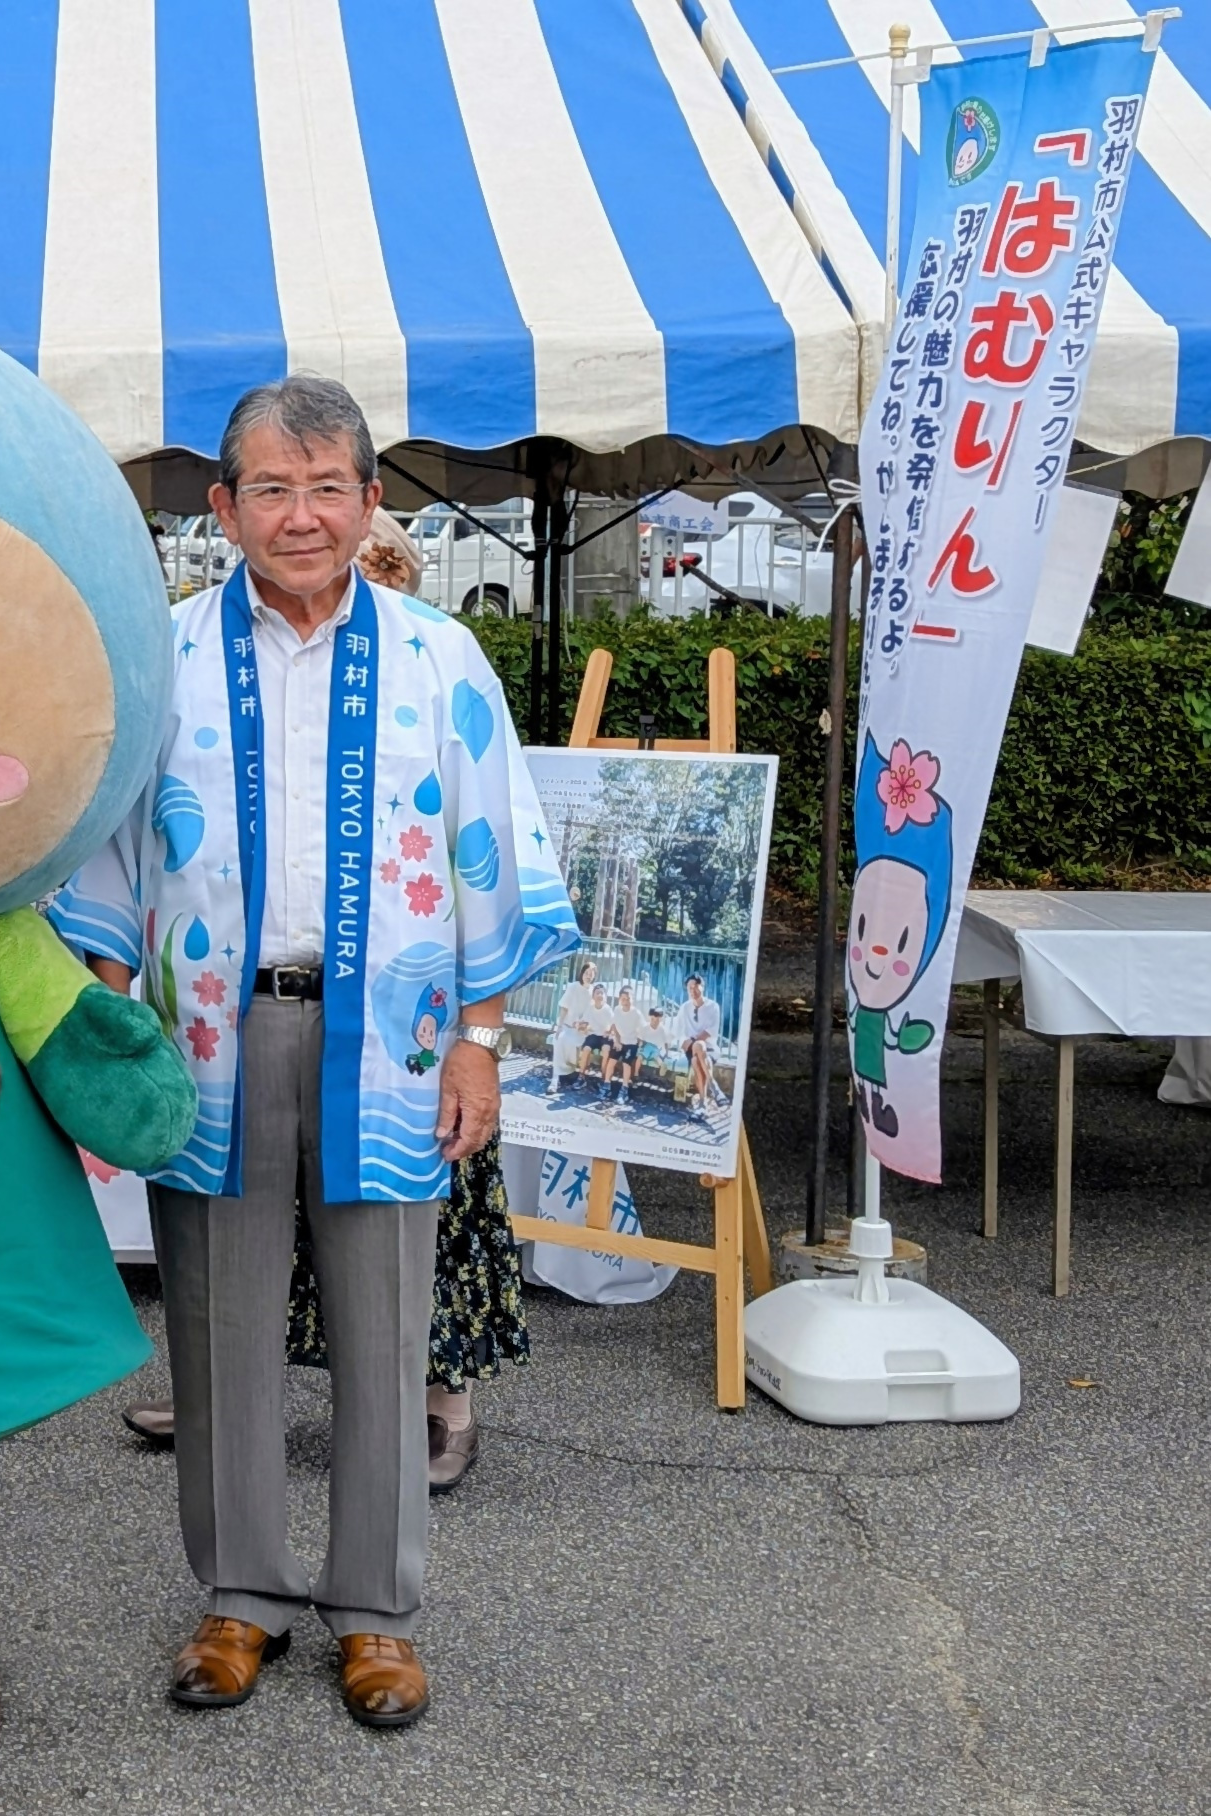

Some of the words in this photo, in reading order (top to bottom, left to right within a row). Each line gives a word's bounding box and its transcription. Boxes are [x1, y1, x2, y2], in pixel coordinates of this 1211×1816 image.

[1034, 99, 1139, 526] 羽村市公式キャラクター
[343, 632, 370, 717] 羽村市
[339, 745, 364, 838] TOKYO
[335, 851, 362, 980] HAMURA
